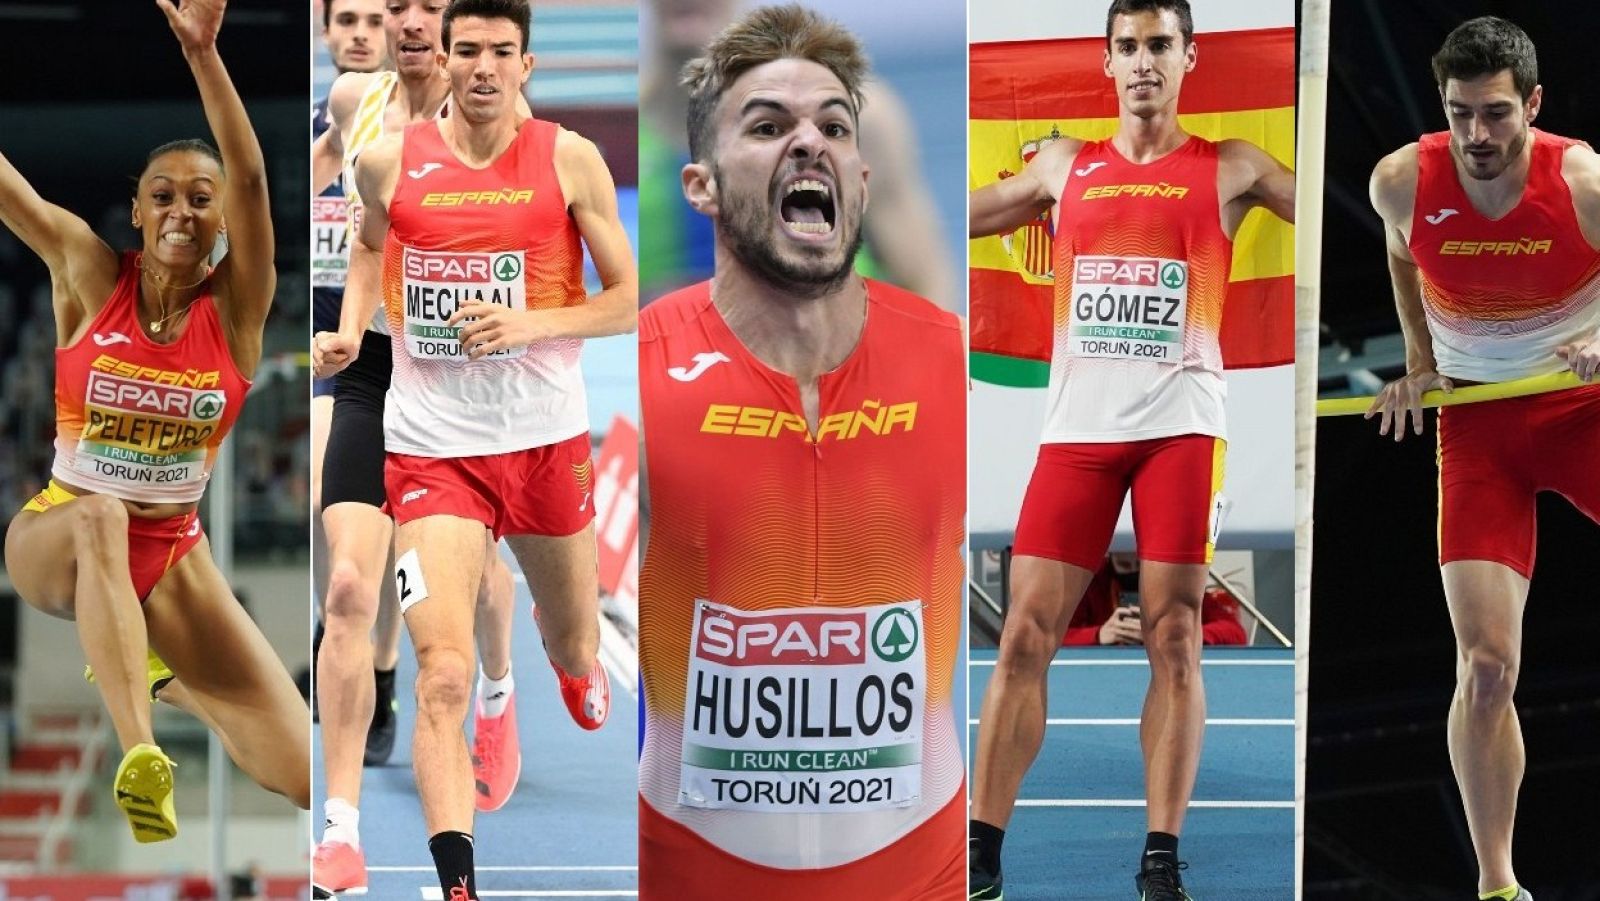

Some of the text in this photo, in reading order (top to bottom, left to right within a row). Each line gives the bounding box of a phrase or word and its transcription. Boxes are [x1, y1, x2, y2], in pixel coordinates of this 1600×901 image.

[420, 187, 535, 207] ESPAÑA
[1081, 180, 1189, 201] ESPAÑA
[1439, 237, 1553, 255] ESPAÑA
[406, 256, 488, 280] SPAR
[1078, 262, 1156, 282] SPAR
[1076, 287, 1179, 327] GÓMEZ
[430, 328, 454, 337] RUN
[1094, 326, 1117, 337] RUN
[1080, 338, 1168, 358] TORUŃ 2021
[91, 353, 220, 389] ESPAÑA
[94, 380, 188, 413] SPAR
[86, 411, 212, 450] PELETEIRO
[700, 398, 918, 443] ESPAÑA
[111, 447, 139, 463] RUN
[93, 458, 189, 482] TORUŃ 2021
[397, 568, 412, 602] 2
[702, 616, 861, 659] SPAR
[692, 670, 914, 739] HUSILLOS
[730, 753, 735, 769] I
[742, 752, 791, 769] RUN
[711, 775, 893, 805] TORUŃ 2021
